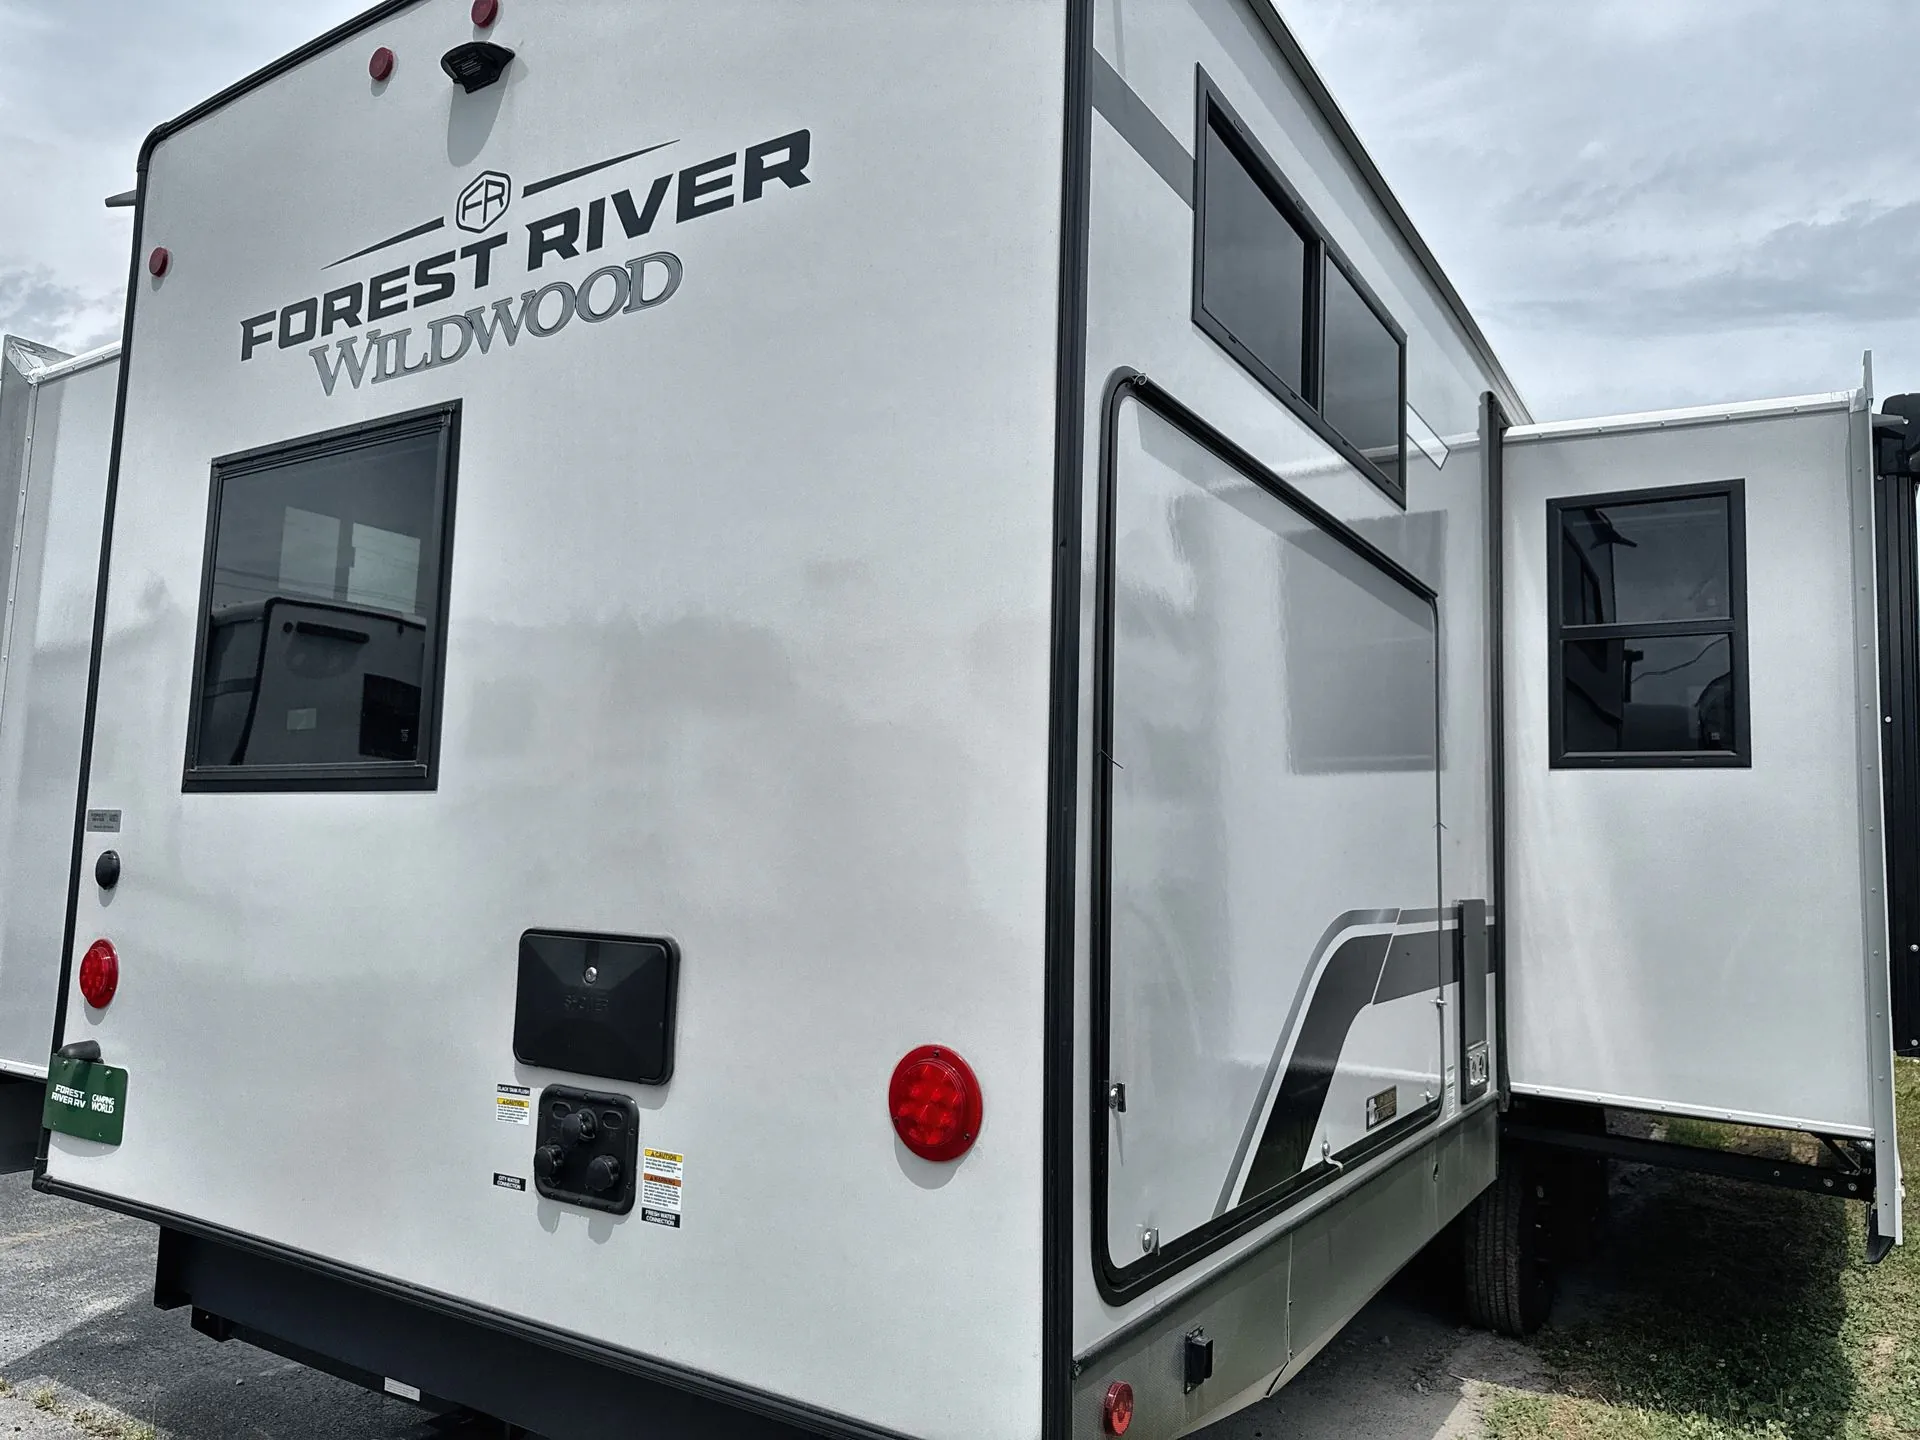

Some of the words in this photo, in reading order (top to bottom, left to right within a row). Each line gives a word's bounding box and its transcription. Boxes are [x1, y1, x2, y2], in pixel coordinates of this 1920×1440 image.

[240, 231, 508, 362] FOREST
[526, 129, 811, 270] RIVER
[309, 251, 683, 396] WILDWOOD
[55, 1084, 85, 1099] FOREST
[51, 1091, 74, 1106] RIVER
[73, 1099, 87, 1109] RV
[92, 1094, 115, 1106] CAMPING
[92, 1101, 114, 1114] WORLD
[645, 1215, 675, 1227] CONNECTION
